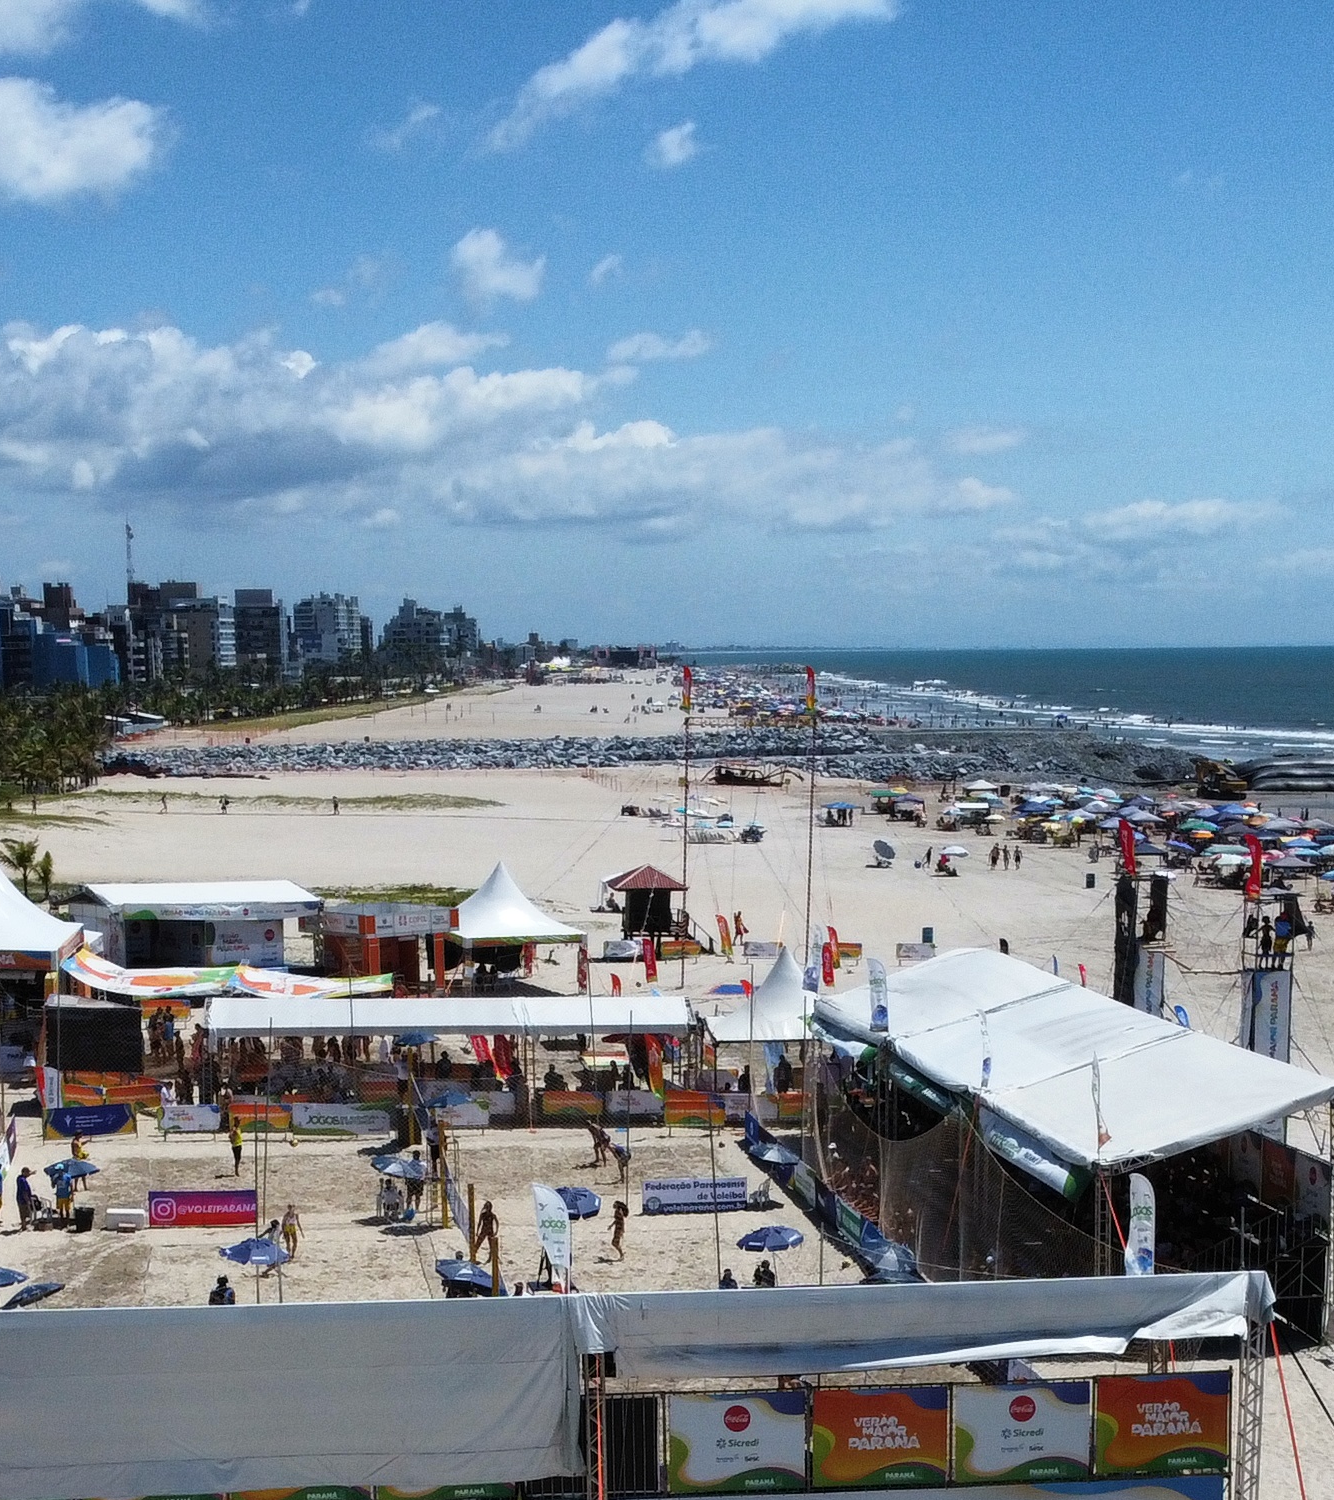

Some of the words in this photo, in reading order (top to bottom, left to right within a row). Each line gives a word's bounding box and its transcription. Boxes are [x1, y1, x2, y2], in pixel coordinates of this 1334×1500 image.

[645, 1182, 692, 1191] Federação
[693, 1180, 745, 1189] Paranaense
[697, 1192, 708, 1200] de
[710, 1191, 746, 1200] Voleibol
[663, 1202, 746, 1212] voleiparanacom.br
[1136, 1399, 1181, 1414] VERÃO
[853, 1413, 899, 1428] VERÃO
[1145, 1411, 1189, 1423] MAIOR
[862, 1425, 907, 1437] MAIOR
[1013, 1428, 1044, 1437] Sicredi
[1131, 1418, 1202, 1437] PARANÁ
[727, 1438, 759, 1448] Sicredi
[848, 1432, 921, 1450] PARANÁ
